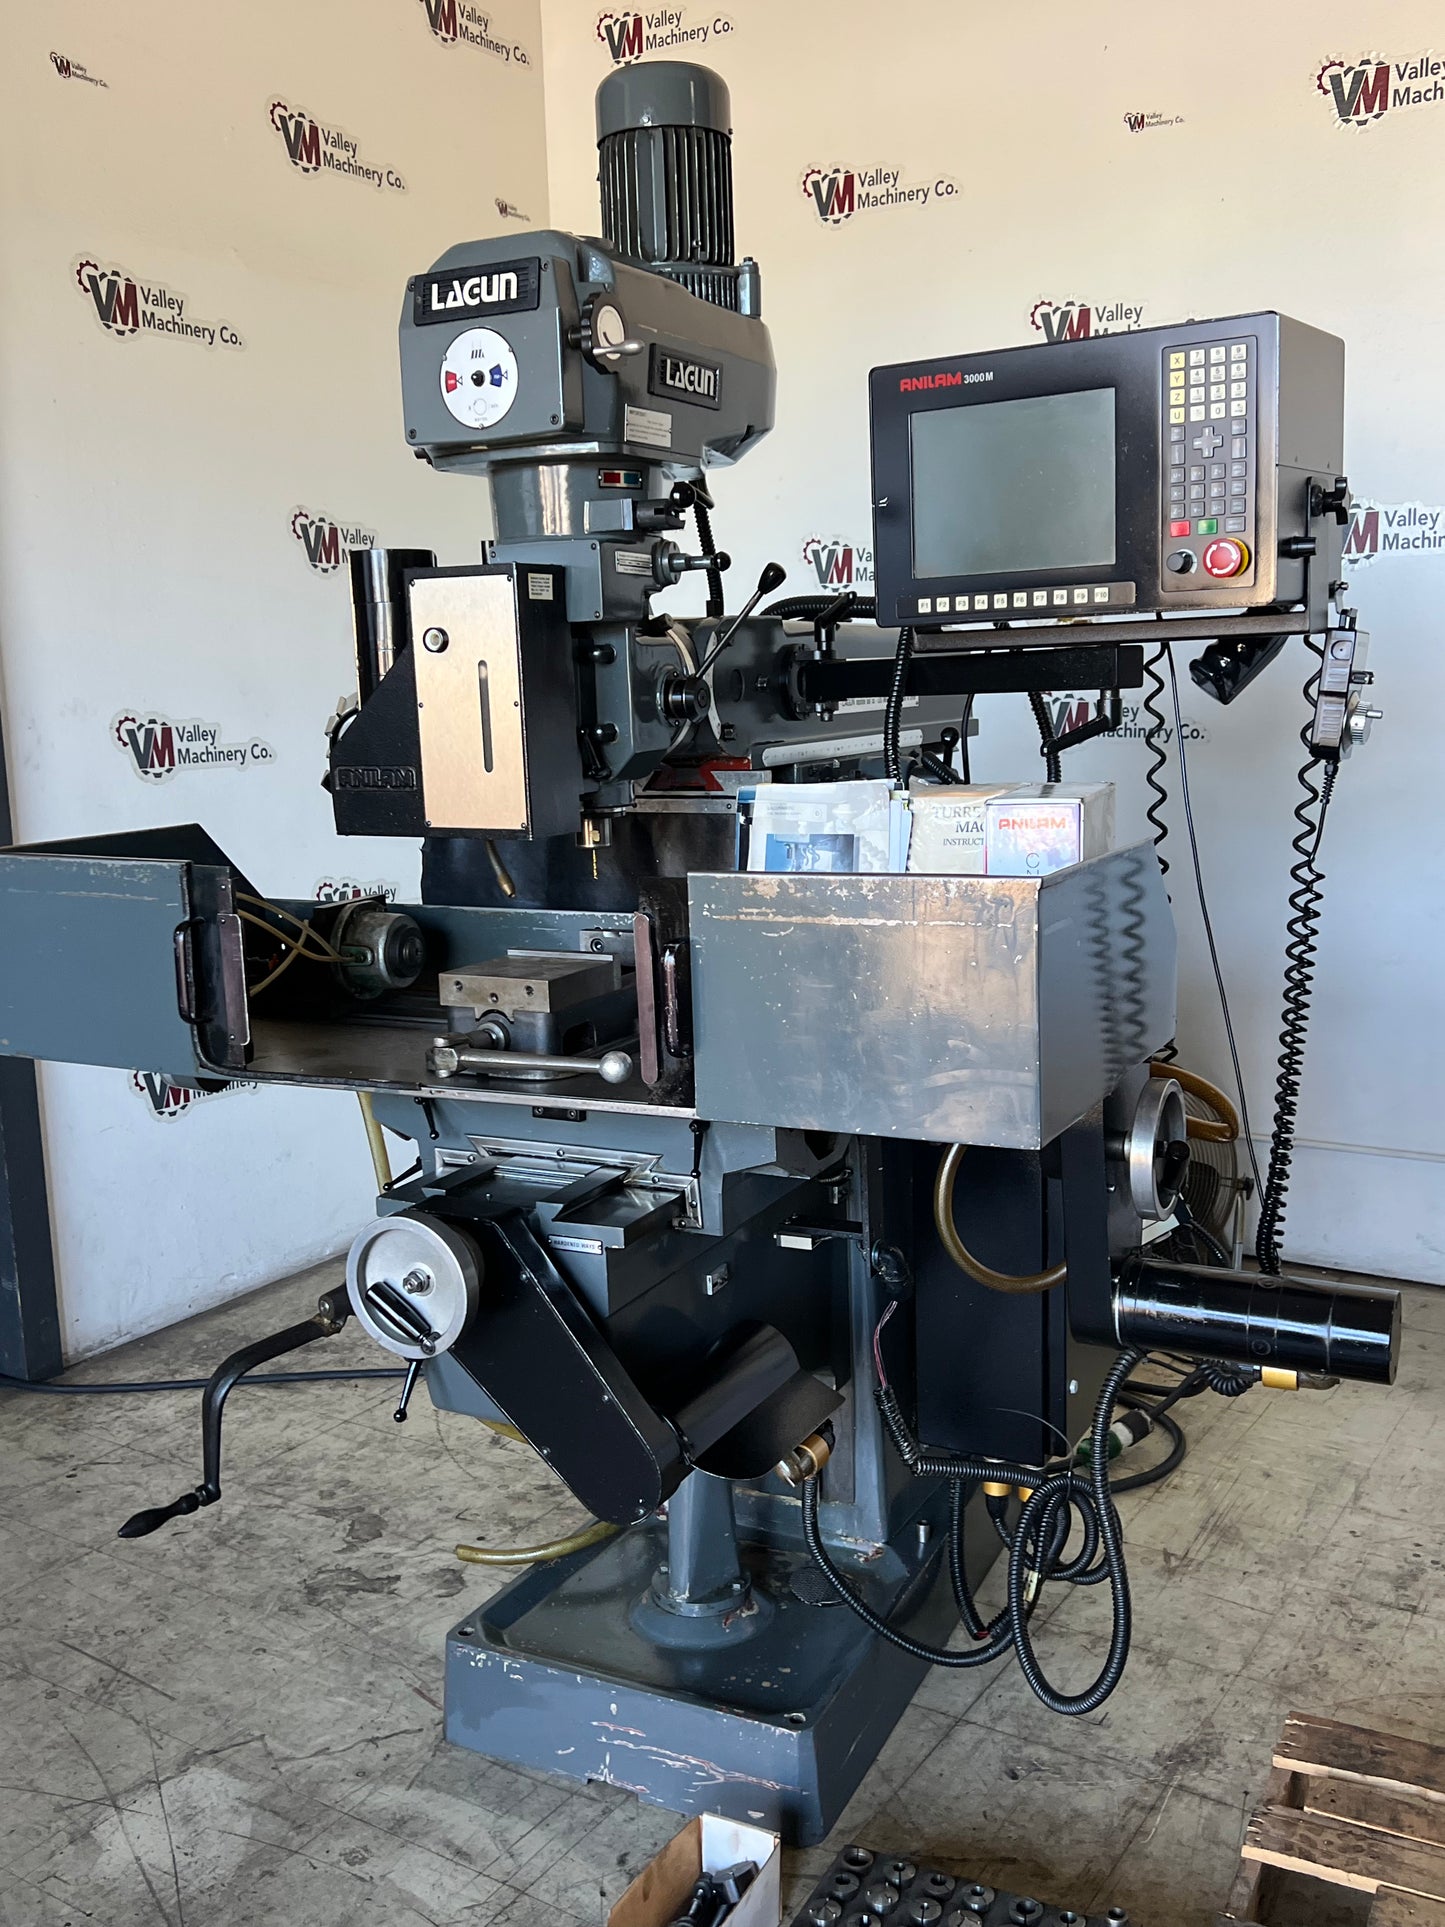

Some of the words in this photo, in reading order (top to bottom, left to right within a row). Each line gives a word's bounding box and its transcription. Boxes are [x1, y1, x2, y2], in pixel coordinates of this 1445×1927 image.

[458, 3, 489, 32] Valley
[645, 9, 682, 31] Valley
[459, 23, 510, 61] Machinery
[513, 46, 529, 64] Co.
[604, 16, 643, 60] VM
[645, 23, 709, 51] Machinery
[712, 18, 734, 33] Co.
[1329, 64, 1391, 118] VM
[278, 113, 321, 166] VM
[321, 128, 357, 158] Valley
[322, 151, 383, 187] Machinery
[386, 170, 405, 189] Co.
[857, 169, 899, 187] Valley
[811, 173, 854, 217] VM
[857, 186, 929, 209] Machinery
[934, 180, 958, 197] Co.
[86, 273, 139, 328] VM
[140, 286, 183, 315] Valley
[431, 271, 518, 311] LAGUN
[142, 310, 215, 344] Machinery
[219, 326, 242, 346] Co.
[1040, 307, 1091, 343] VM
[1095, 303, 1143, 324] Valley
[1174, 356, 1180, 365] X
[665, 357, 715, 396] LAGUN
[900, 372, 961, 391] ANILAM
[1174, 375, 1180, 383] Y
[1174, 392, 1180, 401] Z
[1174, 411, 1180, 420] U
[1384, 508, 1440, 530] Valley
[300, 523, 340, 565] VM
[340, 528, 375, 549] Valley
[811, 548, 853, 584] VM
[175, 725, 216, 745] Valley
[1180, 724, 1204, 740] Co.
[125, 727, 175, 769] VM
[178, 745, 247, 765] Machinery
[250, 743, 272, 760] Co.
[999, 817, 1066, 830] ANILAM
